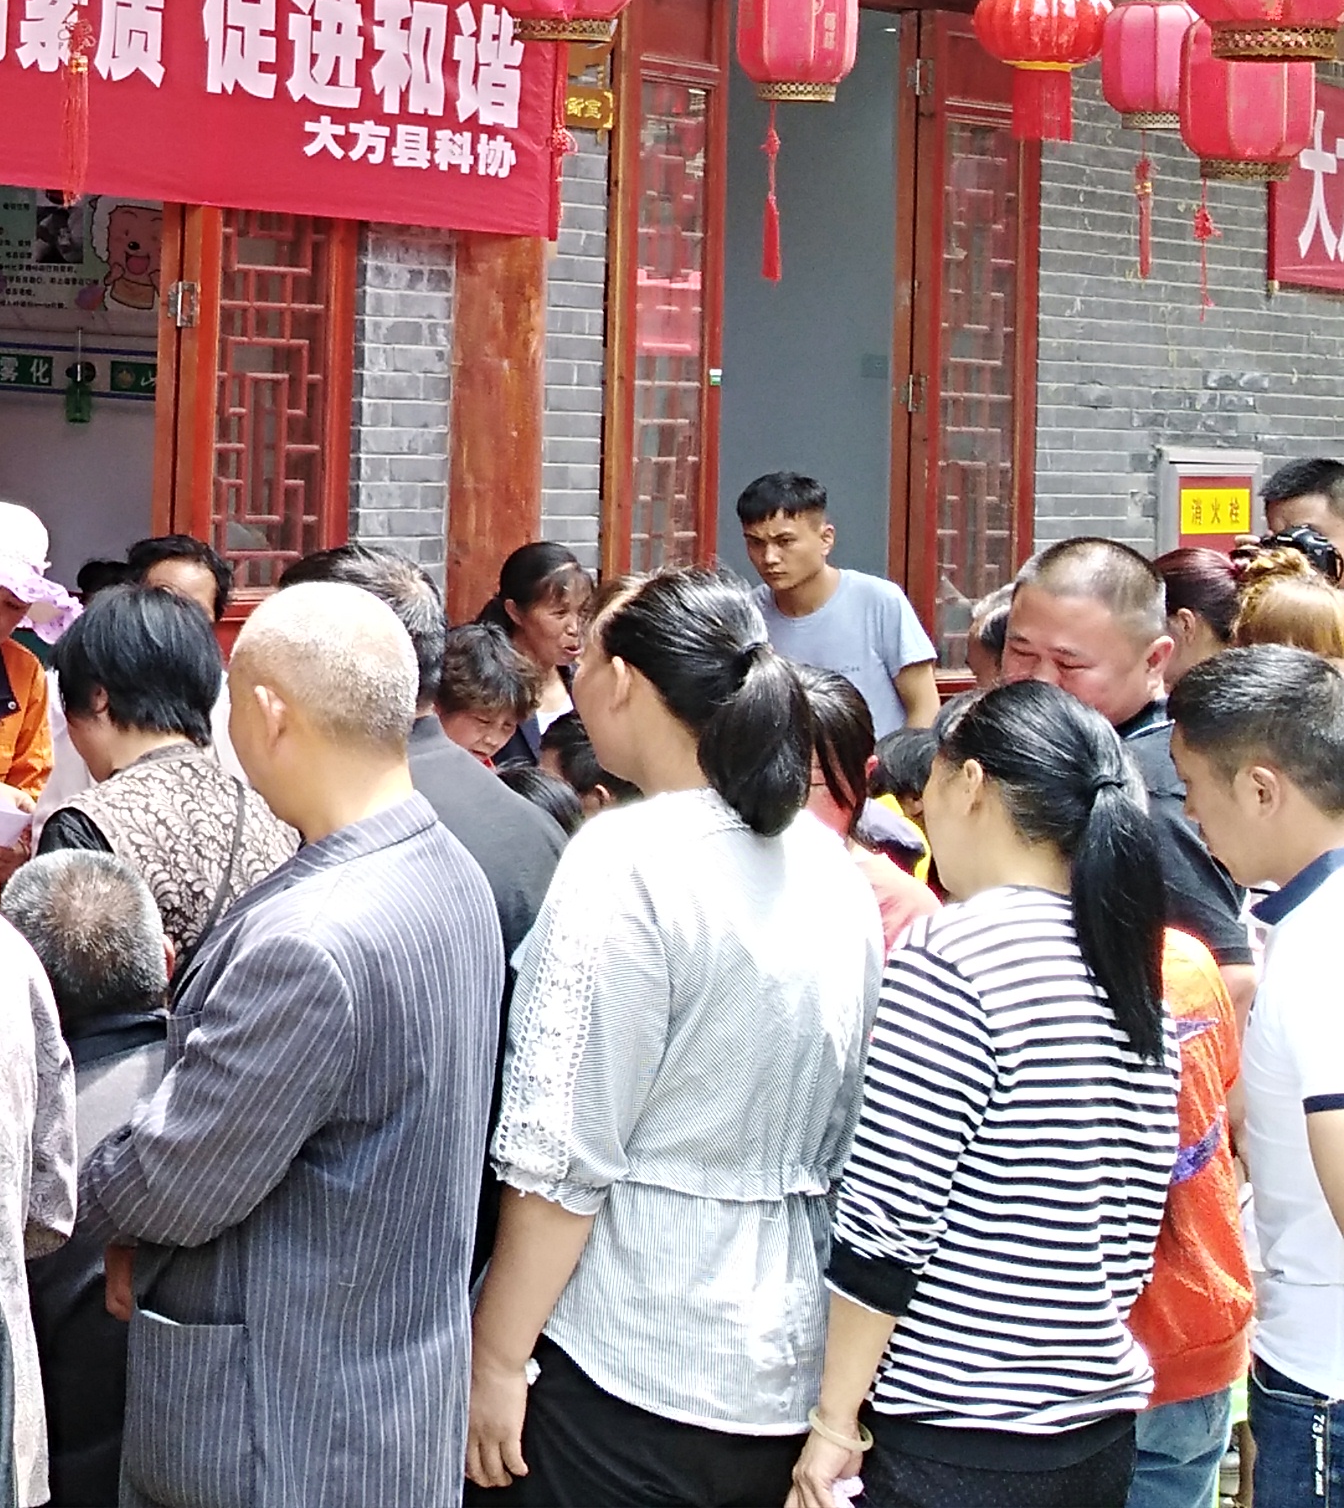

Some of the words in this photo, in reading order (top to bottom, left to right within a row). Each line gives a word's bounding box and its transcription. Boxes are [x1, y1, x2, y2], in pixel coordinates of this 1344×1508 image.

[304, 115, 517, 180] 大方县科协
[1191, 496, 1241, 526] 消火栓
